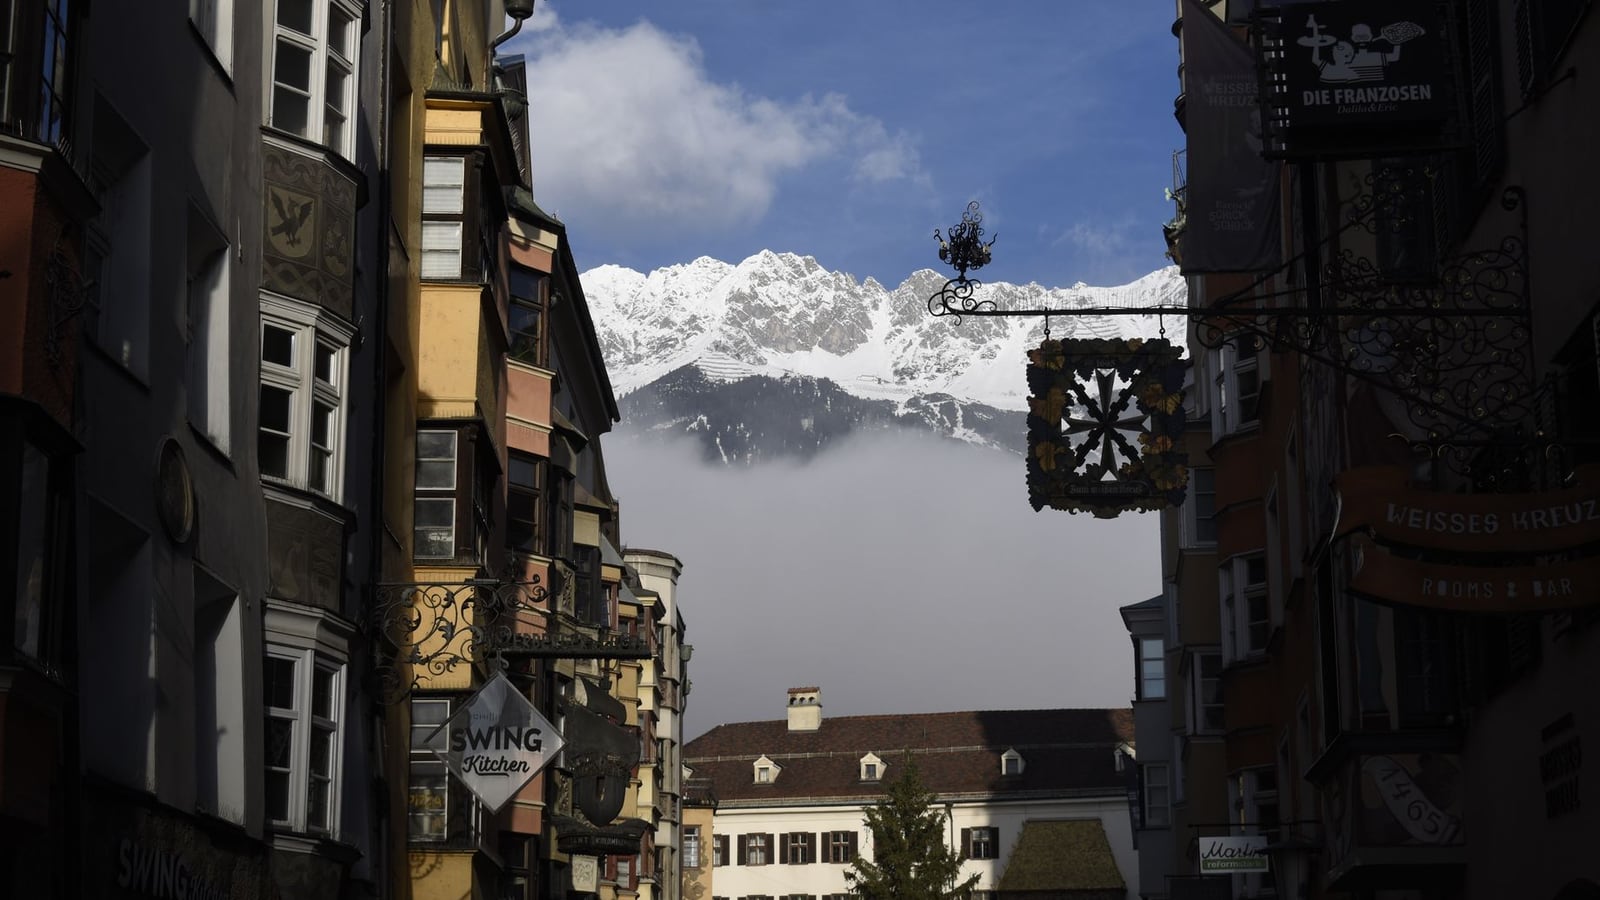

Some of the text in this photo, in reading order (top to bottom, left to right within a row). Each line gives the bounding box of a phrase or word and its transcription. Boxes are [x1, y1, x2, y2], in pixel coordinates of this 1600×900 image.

[1303, 84, 1432, 106] DIE FRANZOSEN
[1386, 499, 1600, 534] WEISSES KREUZ
[1422, 577, 1497, 600] ROOMS
[1532, 577, 1574, 599] BAR
[451, 727, 542, 753] SWING
[462, 755, 530, 778] Kitchen
[117, 838, 192, 900] SWING
